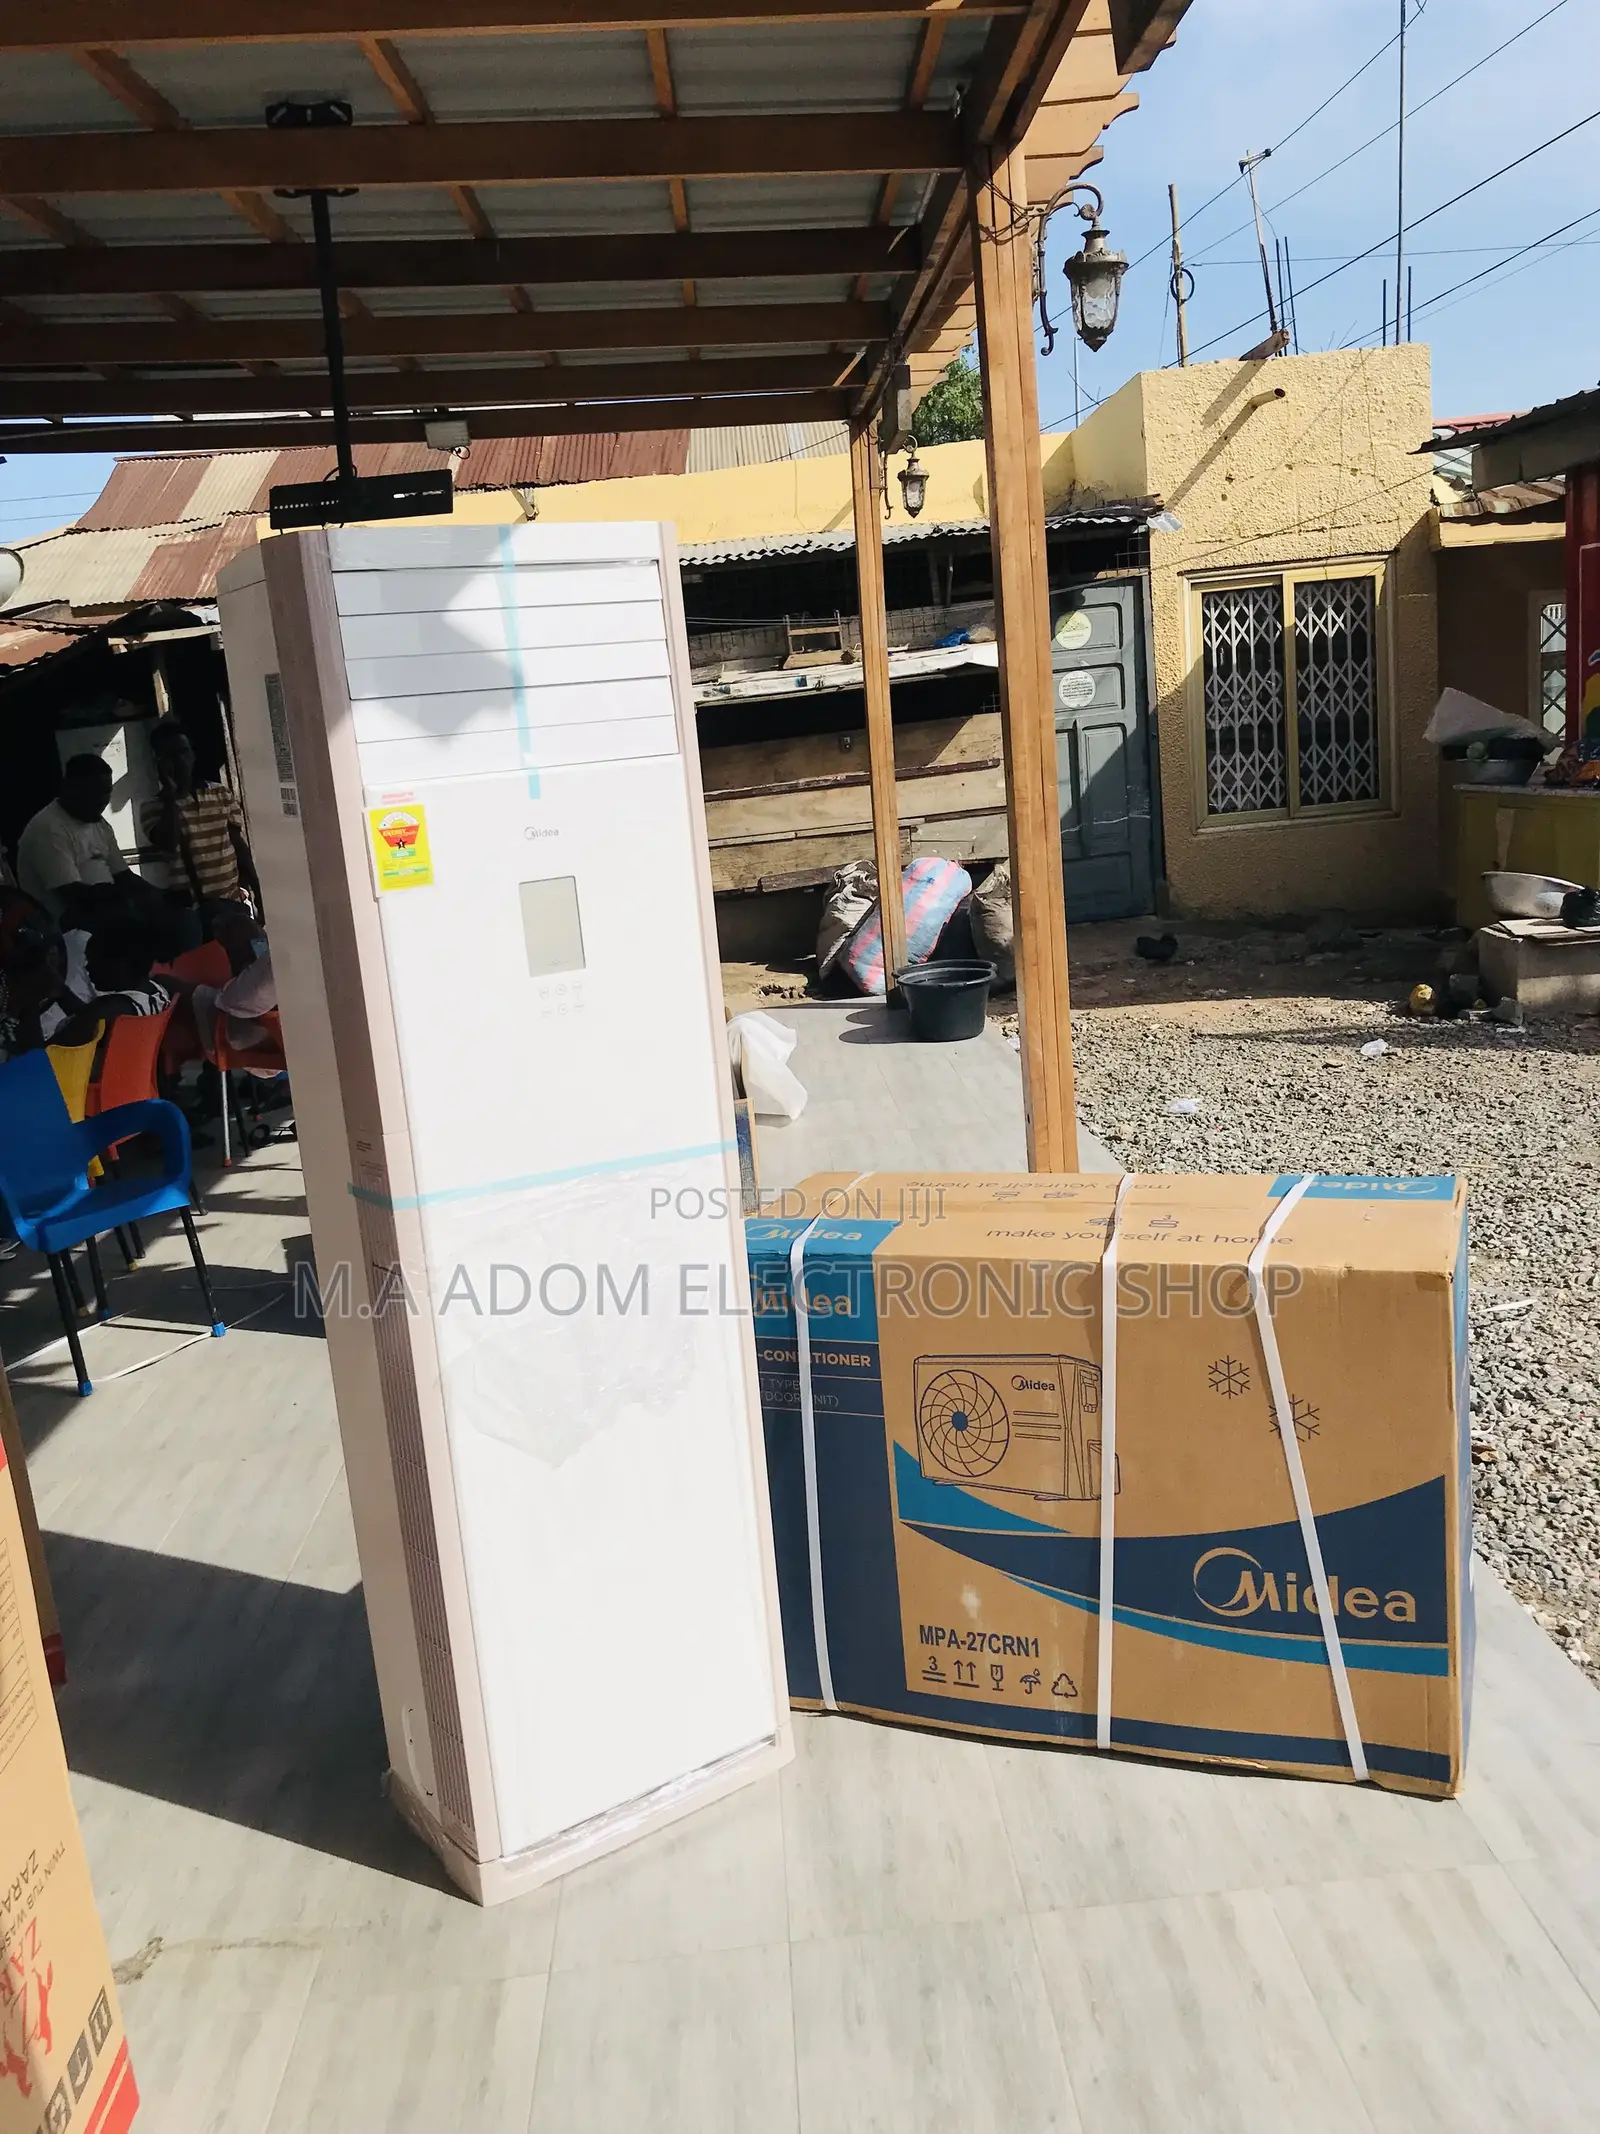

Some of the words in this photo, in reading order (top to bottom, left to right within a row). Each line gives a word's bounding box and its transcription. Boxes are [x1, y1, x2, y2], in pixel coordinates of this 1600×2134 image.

[986, 1228, 1056, 1239] make
[1177, 1234, 1204, 1243] at
[758, 1349, 872, 1368] -CONTIONER
[1011, 1375, 1056, 1391] Midea
[1193, 1546, 1417, 1623] Midea
[919, 1624, 1040, 1658] MPA-27CRN1
[928, 1655, 939, 1671] 3
